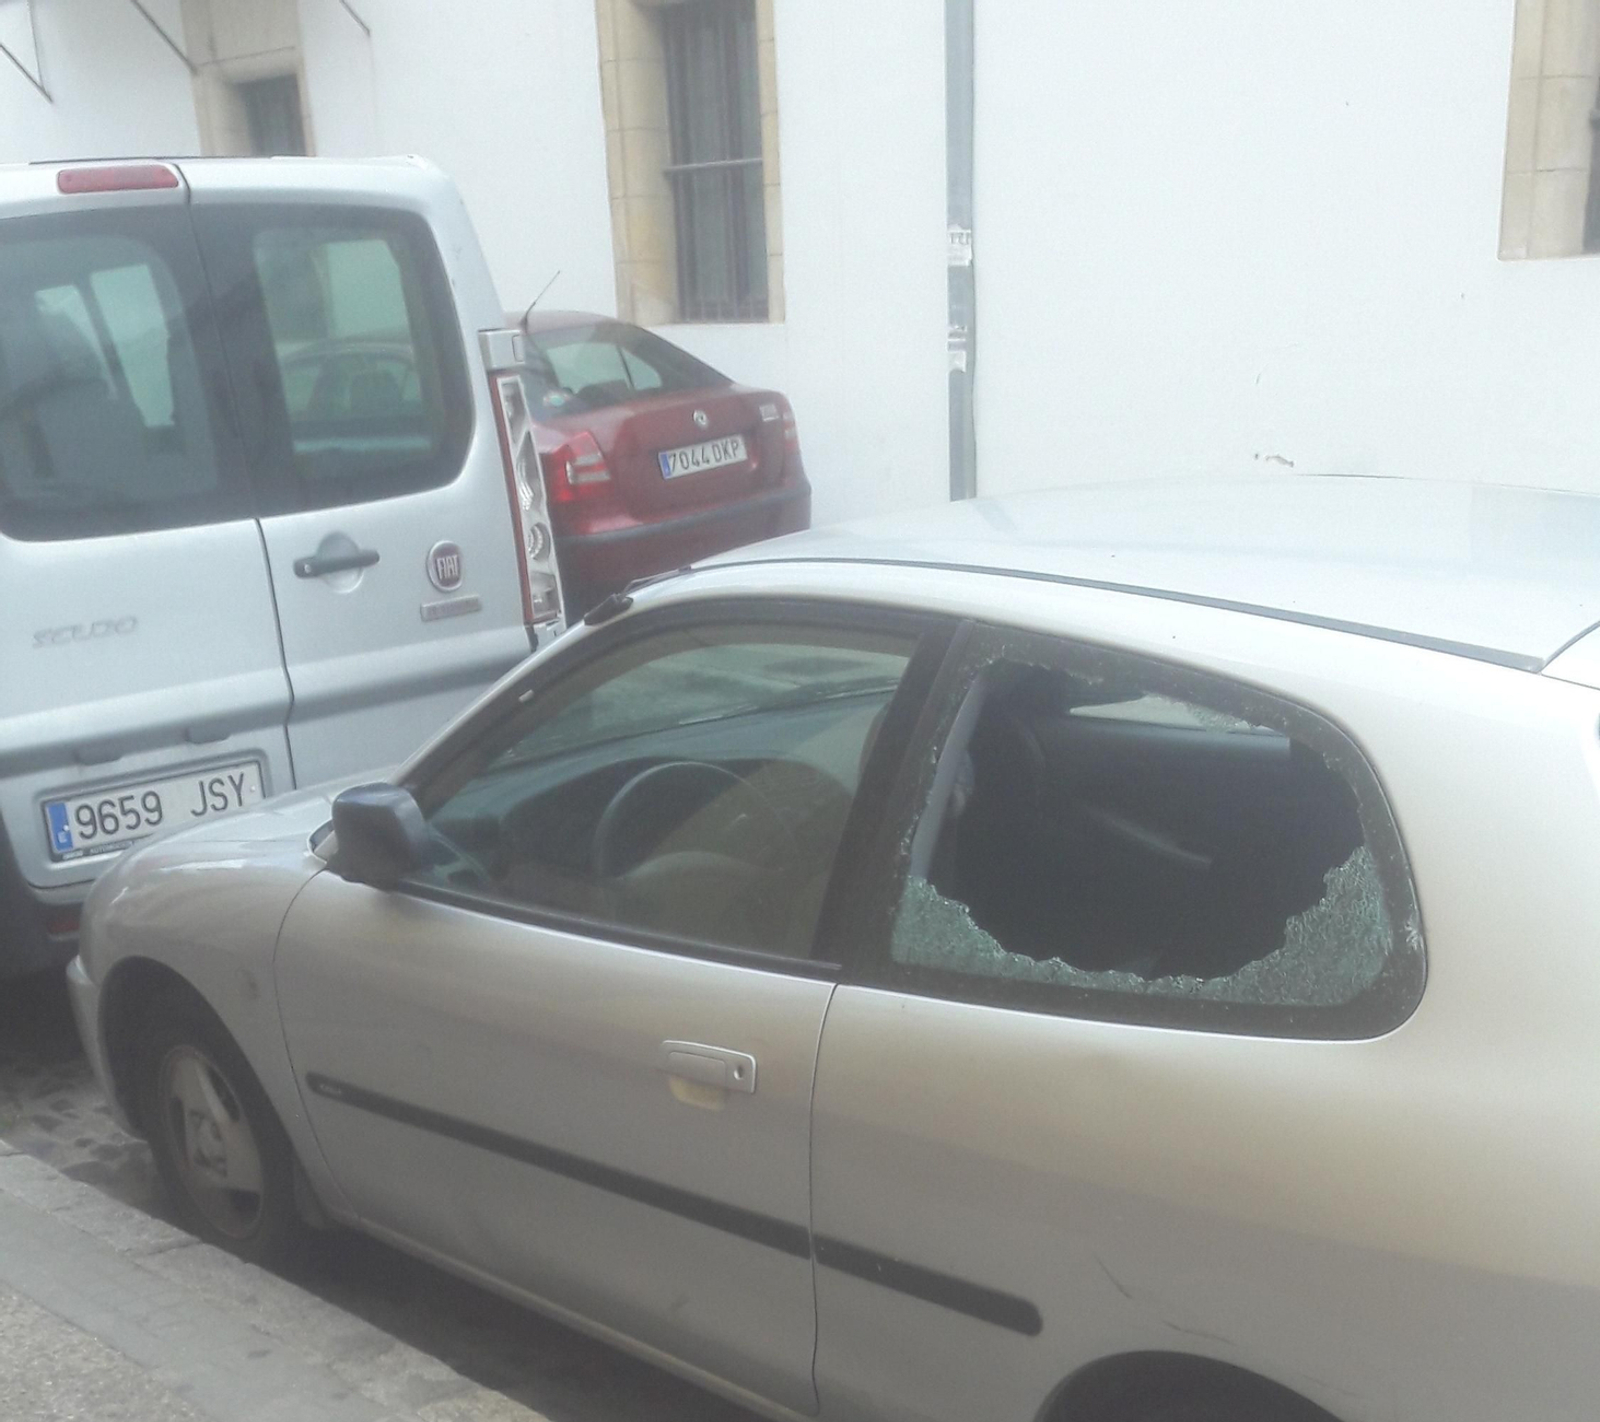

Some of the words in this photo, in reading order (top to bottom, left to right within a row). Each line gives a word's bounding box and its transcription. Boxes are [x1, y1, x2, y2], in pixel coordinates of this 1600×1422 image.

[669, 445, 710, 472] 7044
[712, 440, 739, 463] DKP
[436, 554, 459, 580] FIAT
[75, 790, 163, 839] 9659
[190, 772, 245, 817] JSY
